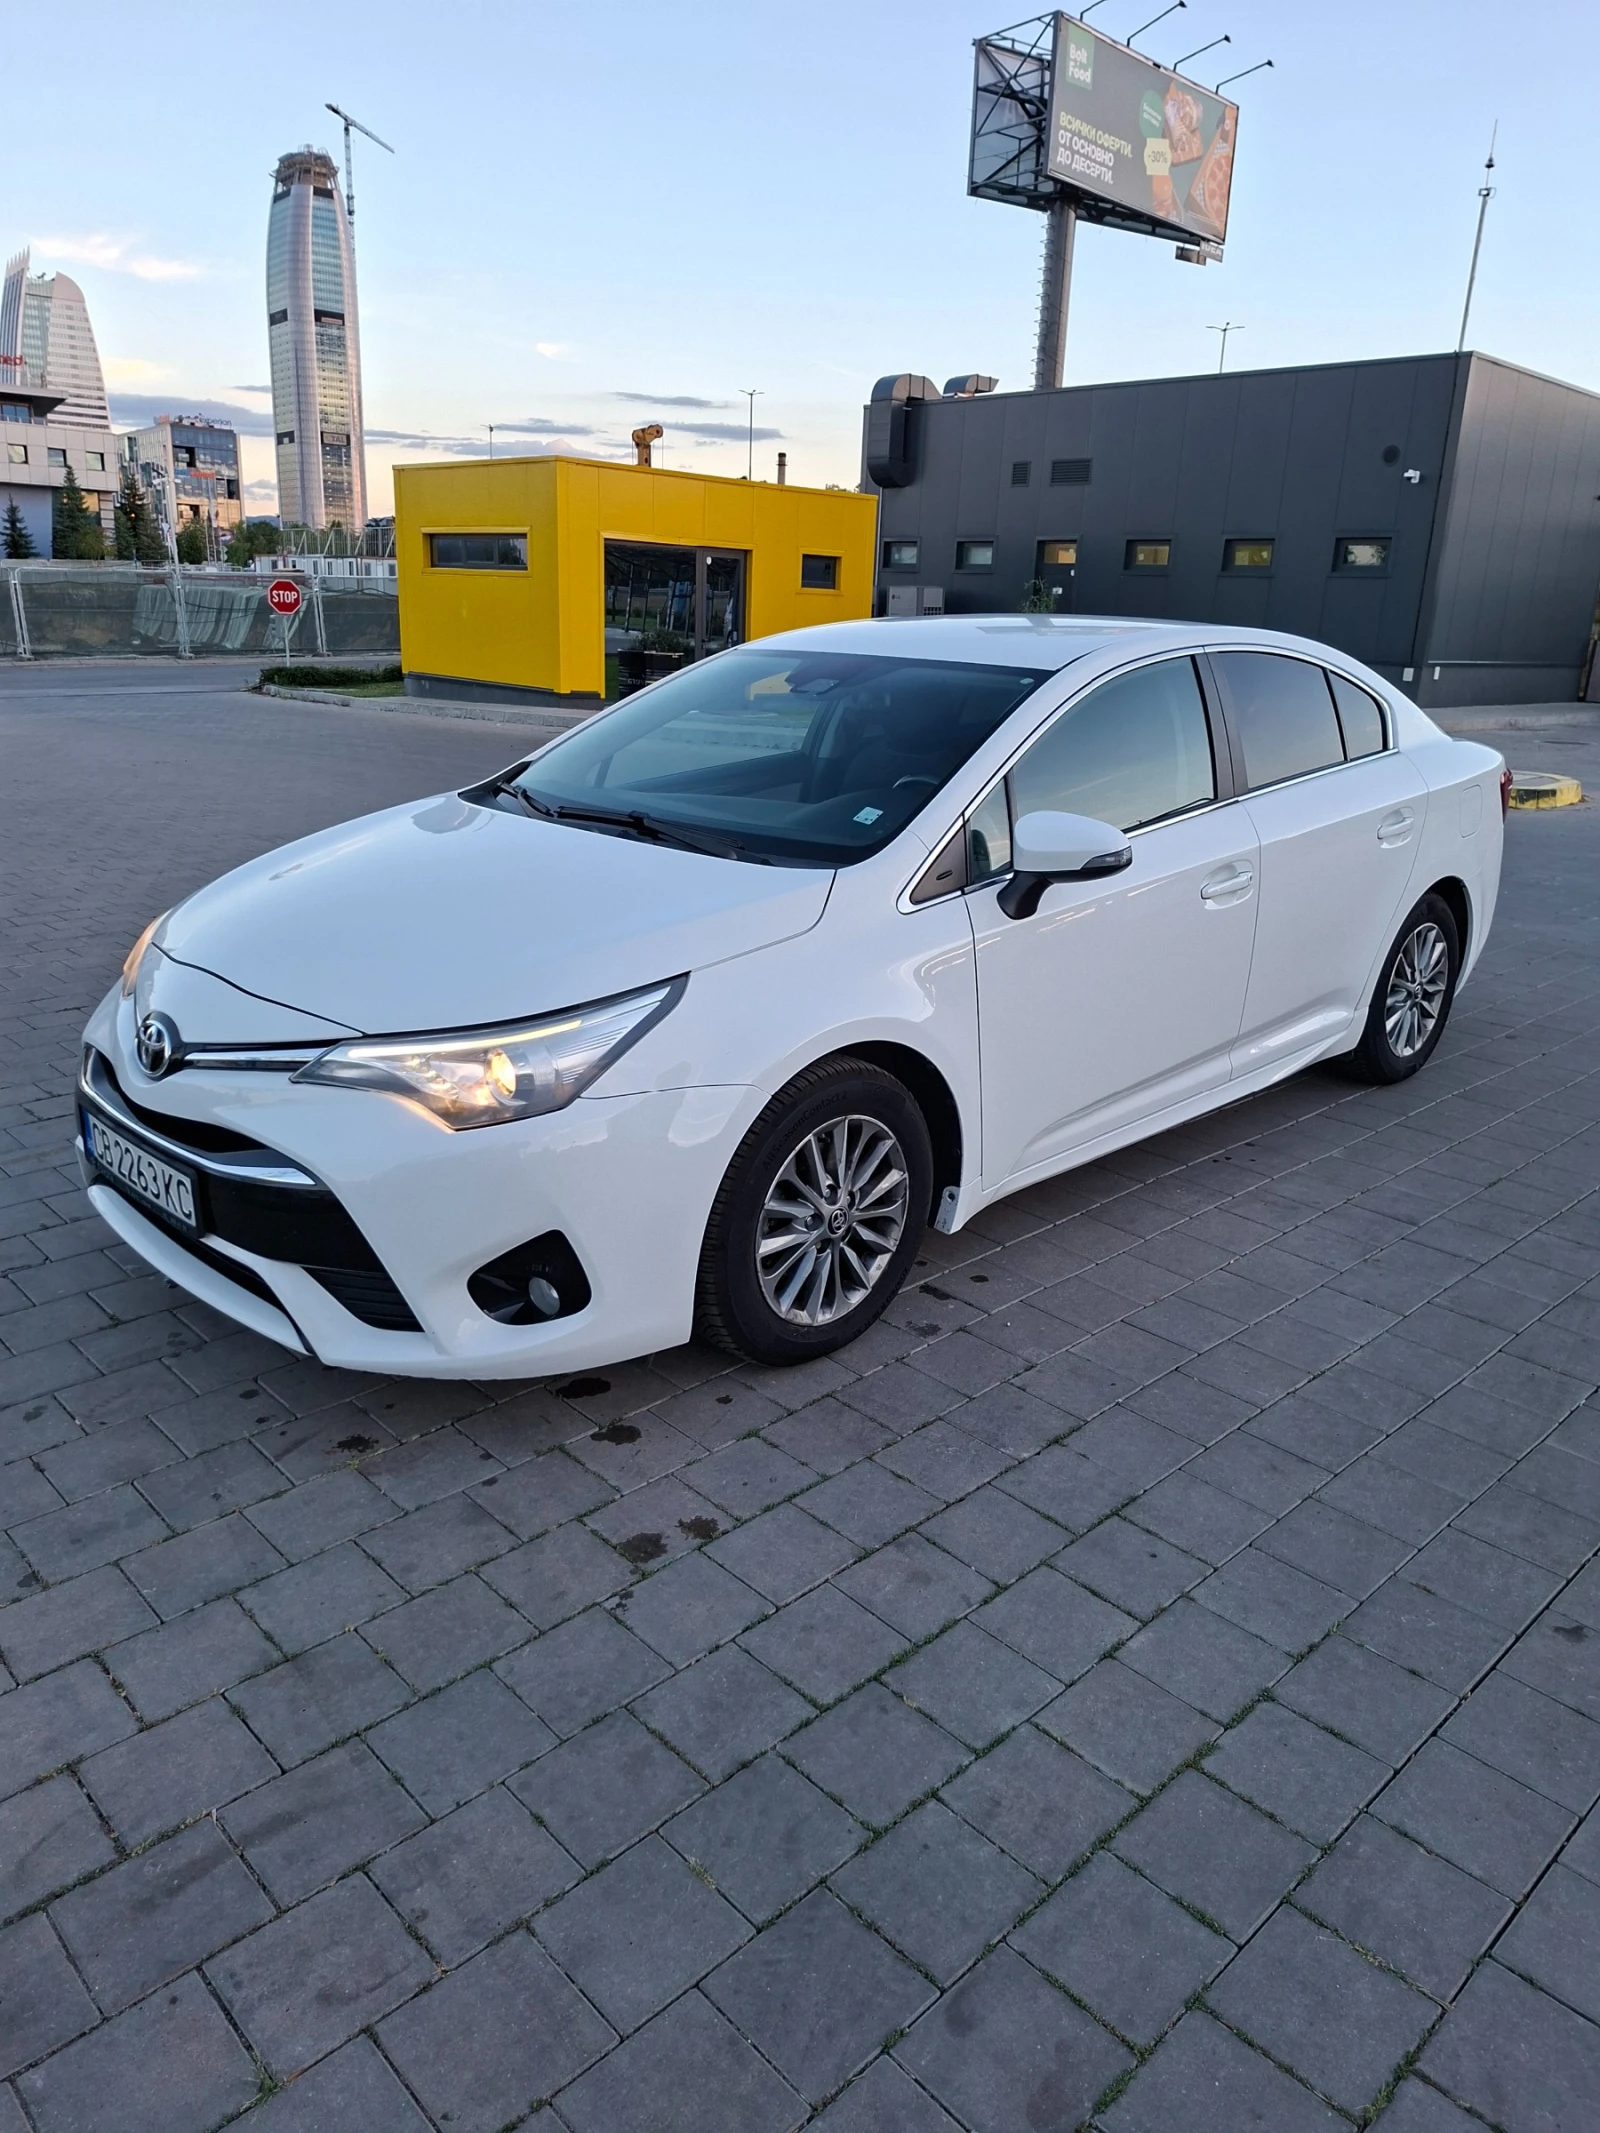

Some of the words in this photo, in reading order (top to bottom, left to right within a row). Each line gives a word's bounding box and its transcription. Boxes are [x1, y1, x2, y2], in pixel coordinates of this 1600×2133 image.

[1069, 43, 1088, 64] Bolt
[1068, 61, 1092, 83] Food
[1058, 129, 1072, 146] ОТ
[1072, 136, 1114, 167] ОСНОВНО
[1059, 111, 1096, 141] ВСИЧКИ
[1096, 130, 1133, 158] ОФЕРТИ.
[1056, 147, 1072, 165] ДО
[1071, 154, 1114, 184] ДЕСЕРТИ.
[1148, 149, 1168, 164] -30%
[272, 590, 298, 604] STOP
[92, 1122, 114, 1168] CB
[114, 1138, 162, 1202] 2263
[161, 1167, 193, 1221] KC
